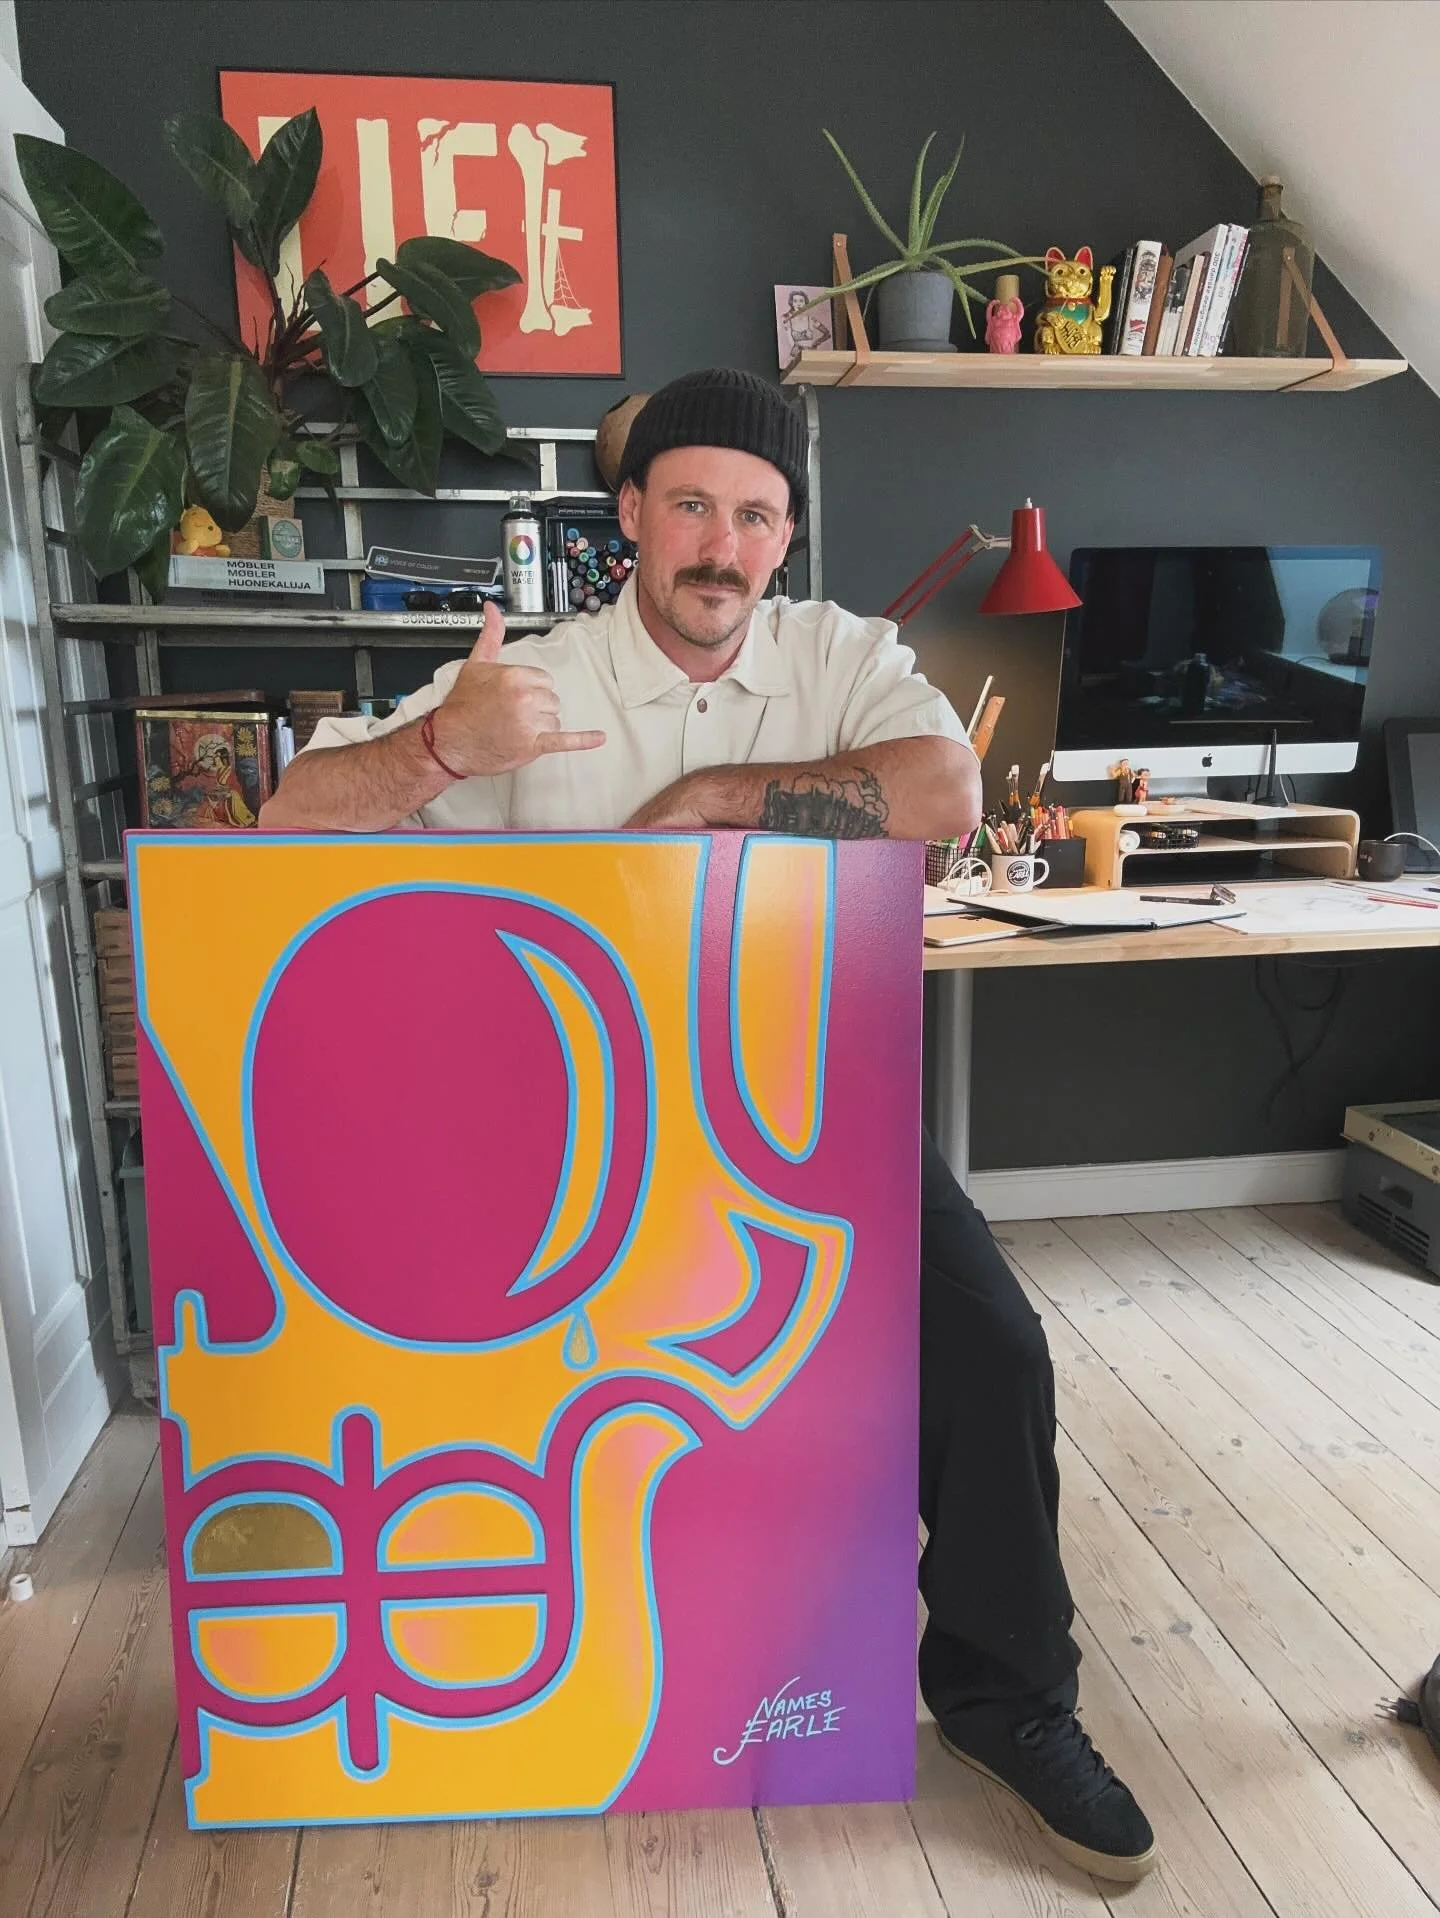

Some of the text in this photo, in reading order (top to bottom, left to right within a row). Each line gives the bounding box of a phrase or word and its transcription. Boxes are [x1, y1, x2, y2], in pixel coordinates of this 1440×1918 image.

[228, 579, 311, 590] HUONEKALUJA
[752, 1676, 832, 1722] NAMES
[713, 1706, 846, 1766] EARLE
